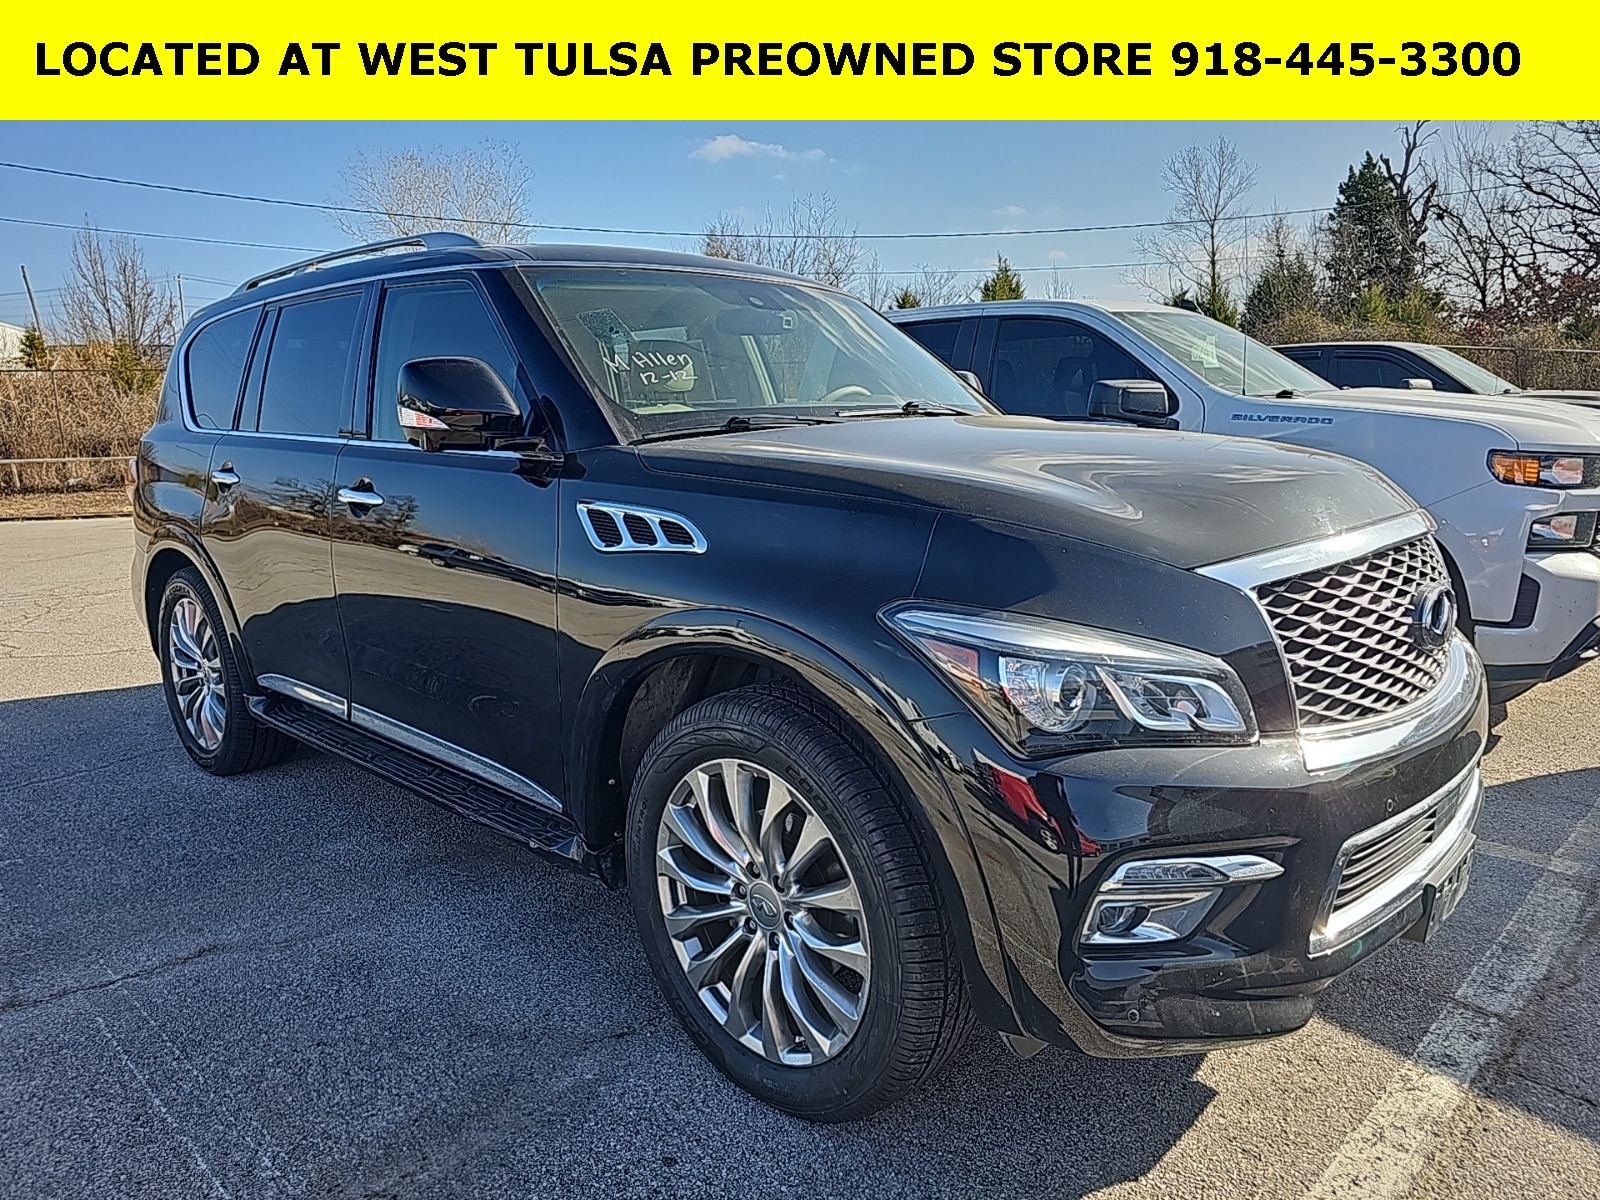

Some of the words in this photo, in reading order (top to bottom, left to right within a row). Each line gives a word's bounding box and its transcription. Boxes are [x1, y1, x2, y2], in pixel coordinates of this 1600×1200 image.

[602, 353, 630, 374] M
[632, 351, 693, 368] Allen
[640, 370, 698, 385] 12-12
[1230, 412, 1334, 426] SILVERADO
